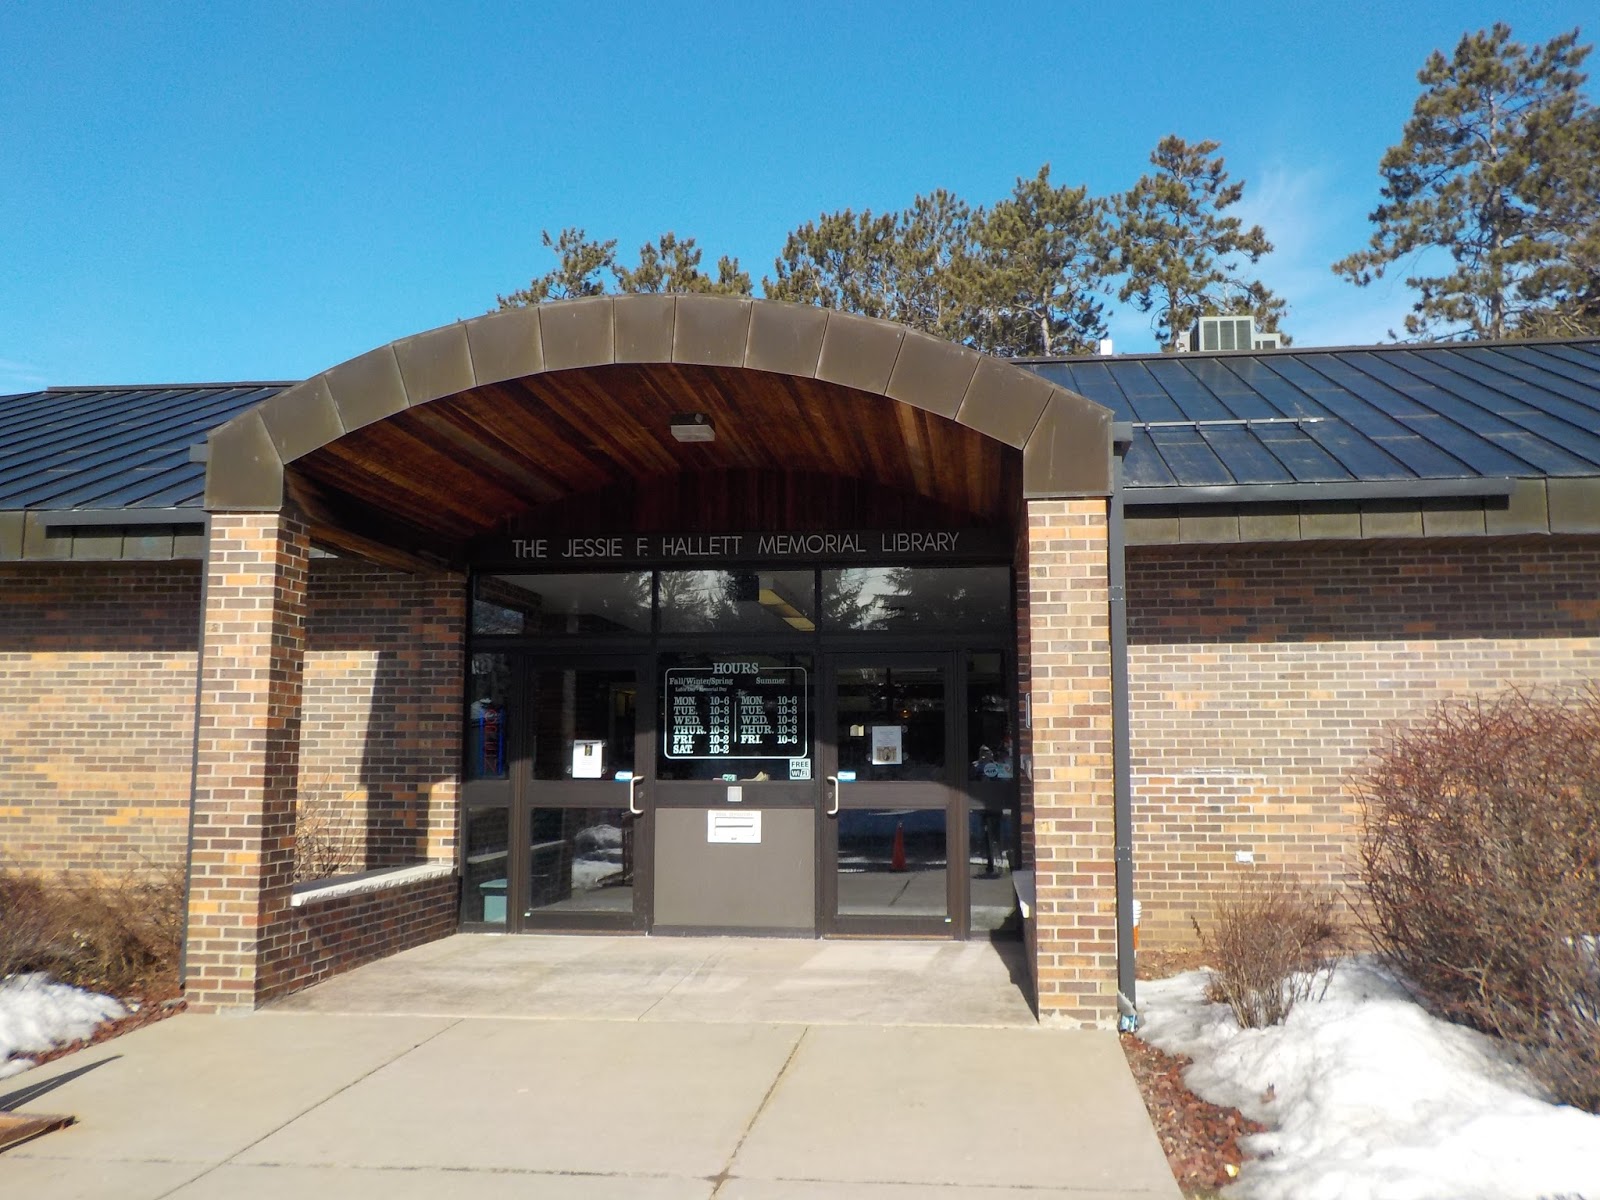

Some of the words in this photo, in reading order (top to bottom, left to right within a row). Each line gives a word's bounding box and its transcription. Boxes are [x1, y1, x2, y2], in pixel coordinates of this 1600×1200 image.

[512, 539, 547, 558] THE
[561, 538, 622, 557] JESSIE
[636, 537, 648, 556] F.
[662, 536, 743, 556] HALLETT
[758, 534, 866, 554] MEMORIAL
[881, 532, 960, 552] LIBRARY
[713, 662, 759, 674] HOURS
[755, 677, 786, 685] Summer
[673, 696, 697, 705] MON.
[709, 696, 730, 705] 10-6
[741, 696, 764, 705] MON.
[777, 696, 798, 705] 10-6
[673, 706, 698, 715] TUE.
[709, 706, 730, 715] 10-8
[741, 706, 765, 715] TUE.
[777, 706, 798, 715] 10-8
[673, 716, 701, 725] WED.
[709, 716, 730, 725] 10-6
[741, 715, 768, 724] WED.
[777, 715, 798, 724] 10-6
[673, 725, 707, 734] THUR.
[709, 725, 730, 734] 10-8
[741, 725, 775, 734] THUR.
[777, 725, 798, 734] 10-8
[673, 735, 696, 744] FRI.
[709, 735, 730, 744] 10-2
[741, 735, 763, 744] FRI.
[777, 735, 798, 744] 10-6
[673, 745, 694, 754] SAT.
[709, 745, 730, 754] 10-2
